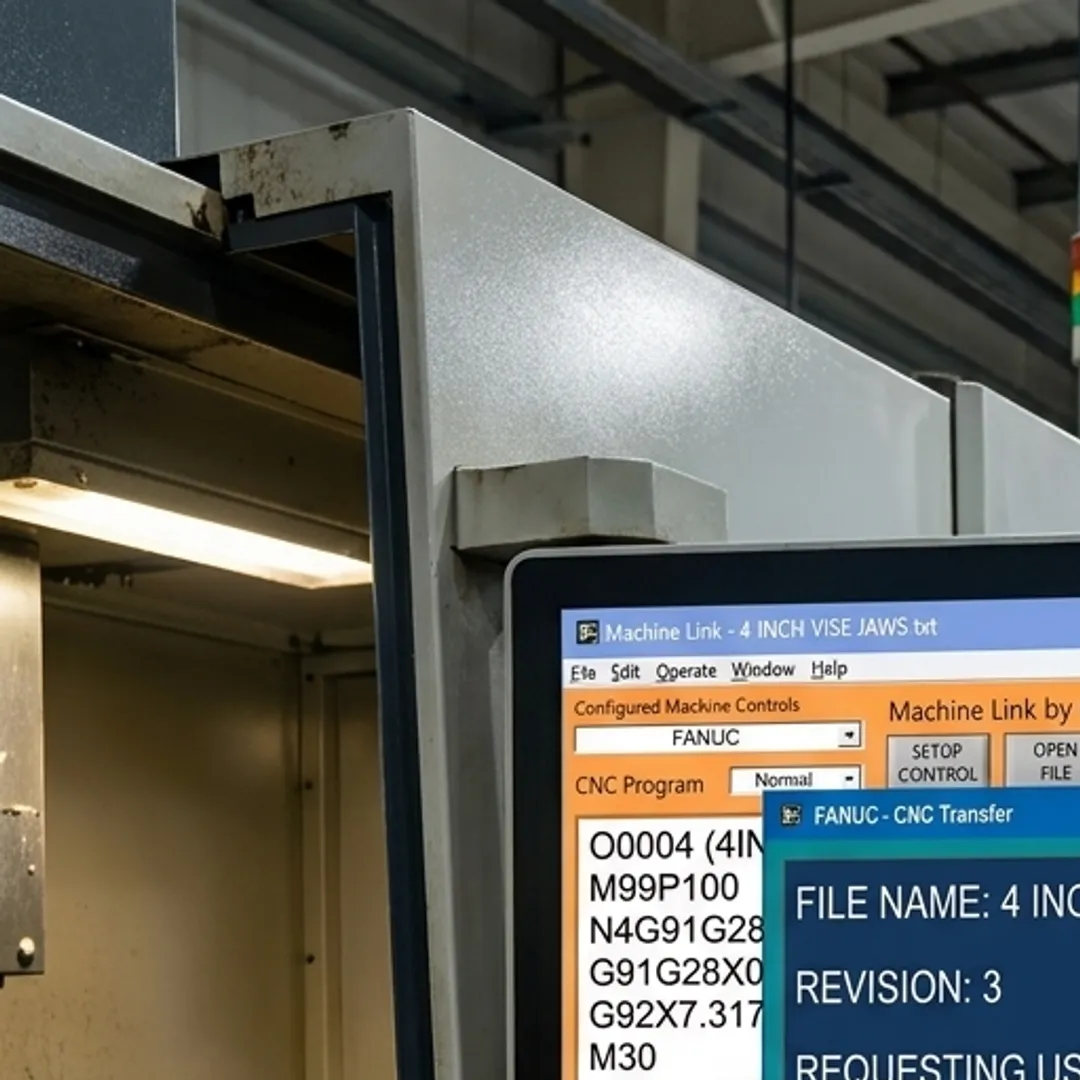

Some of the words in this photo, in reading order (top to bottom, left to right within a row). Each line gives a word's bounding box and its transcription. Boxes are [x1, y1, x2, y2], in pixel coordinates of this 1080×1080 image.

[605, 621, 680, 642] Machine
[685, 619, 723, 640] Link
[739, 620, 750, 639] 4
[757, 618, 806, 638] INCH
[810, 616, 853, 638] VISE
[655, 662, 717, 683] Operate
[574, 698, 662, 721] Configured
[735, 696, 801, 713] Controls
[889, 699, 985, 723] Machine
[991, 698, 1037, 721] Link
[1044, 696, 1074, 727] by
[672, 727, 741, 748] FANUC
[1032, 741, 1079, 759] OPEN
[754, 770, 814, 789] Normal
[897, 765, 979, 784] CONTROL
[1039, 764, 1073, 782] FILE
[575, 775, 618, 796] CNC
[622, 773, 705, 800] Program
[813, 804, 880, 826] FANUC
[893, 803, 935, 825] CNC
[938, 802, 1015, 824] Transfer
[589, 872, 740, 902] M99P100
[796, 884, 869, 920] FILE
[879, 883, 990, 919] NAME:
[999, 882, 1021, 918] 4
[589, 915, 764, 945] N4G91G28
[796, 968, 972, 1005] REVISION:
[982, 968, 1002, 1005] 3
[589, 999, 763, 1029] G92X7.317
[589, 1042, 657, 1072] M30
